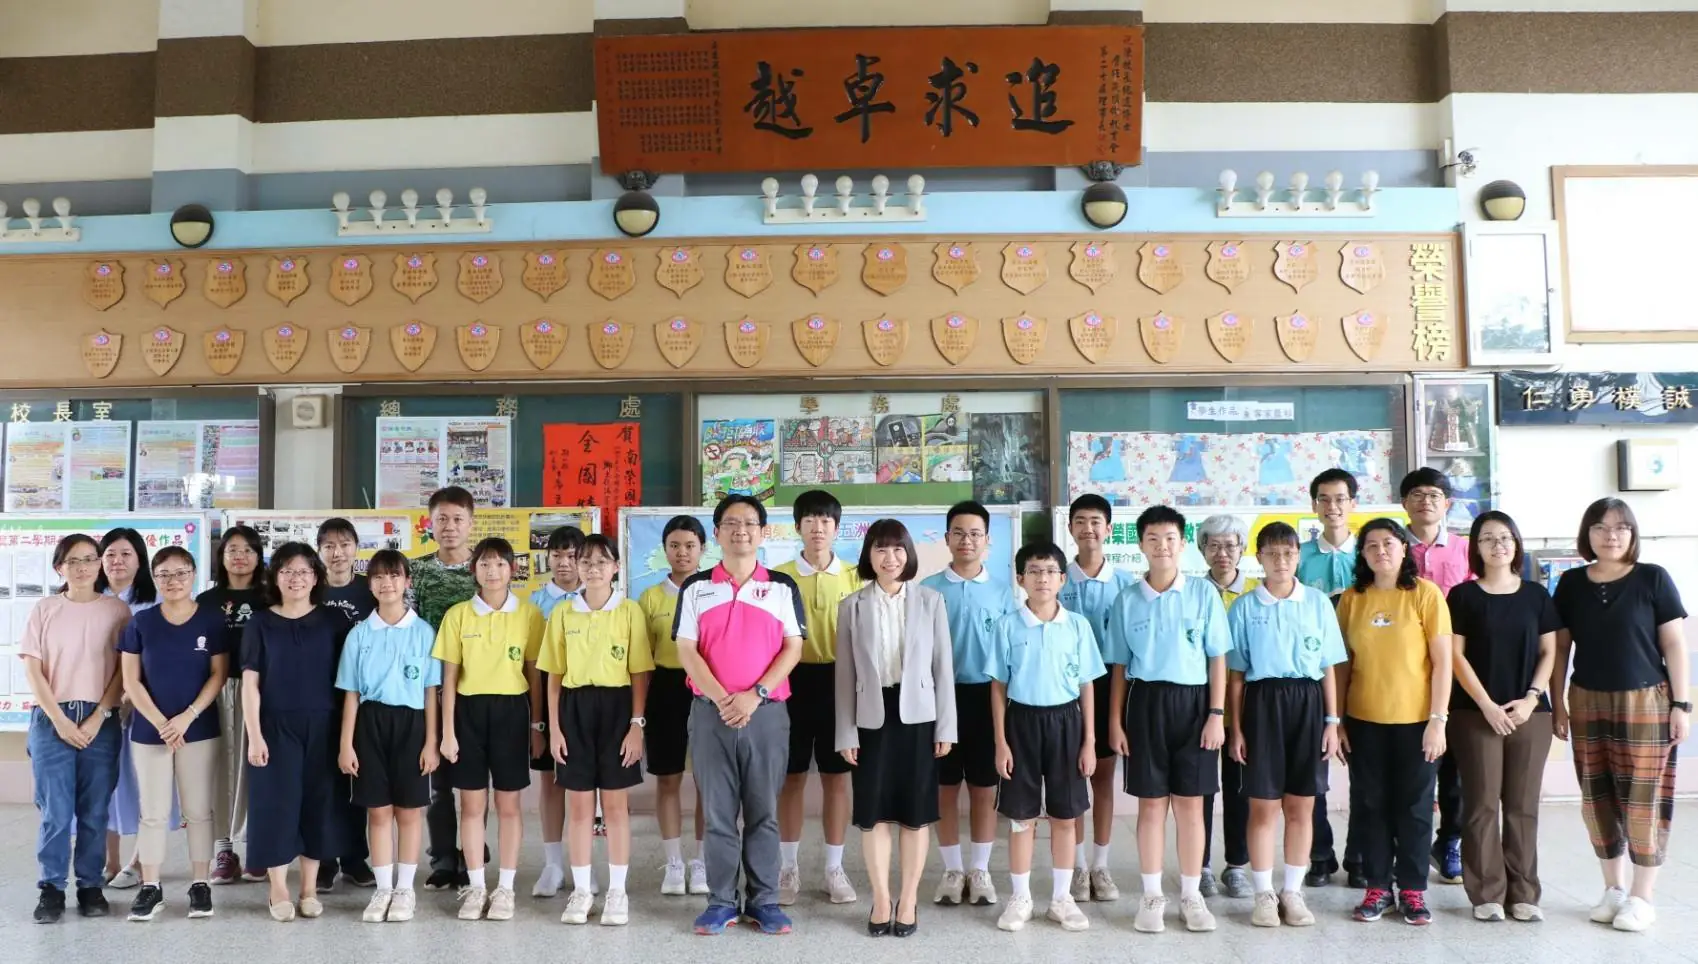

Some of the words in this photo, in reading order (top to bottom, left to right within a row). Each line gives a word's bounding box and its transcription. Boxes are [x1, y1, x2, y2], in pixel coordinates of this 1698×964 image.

[1408, 243, 1451, 361] 榮譽榜
[10, 401, 113, 423] 校長室
